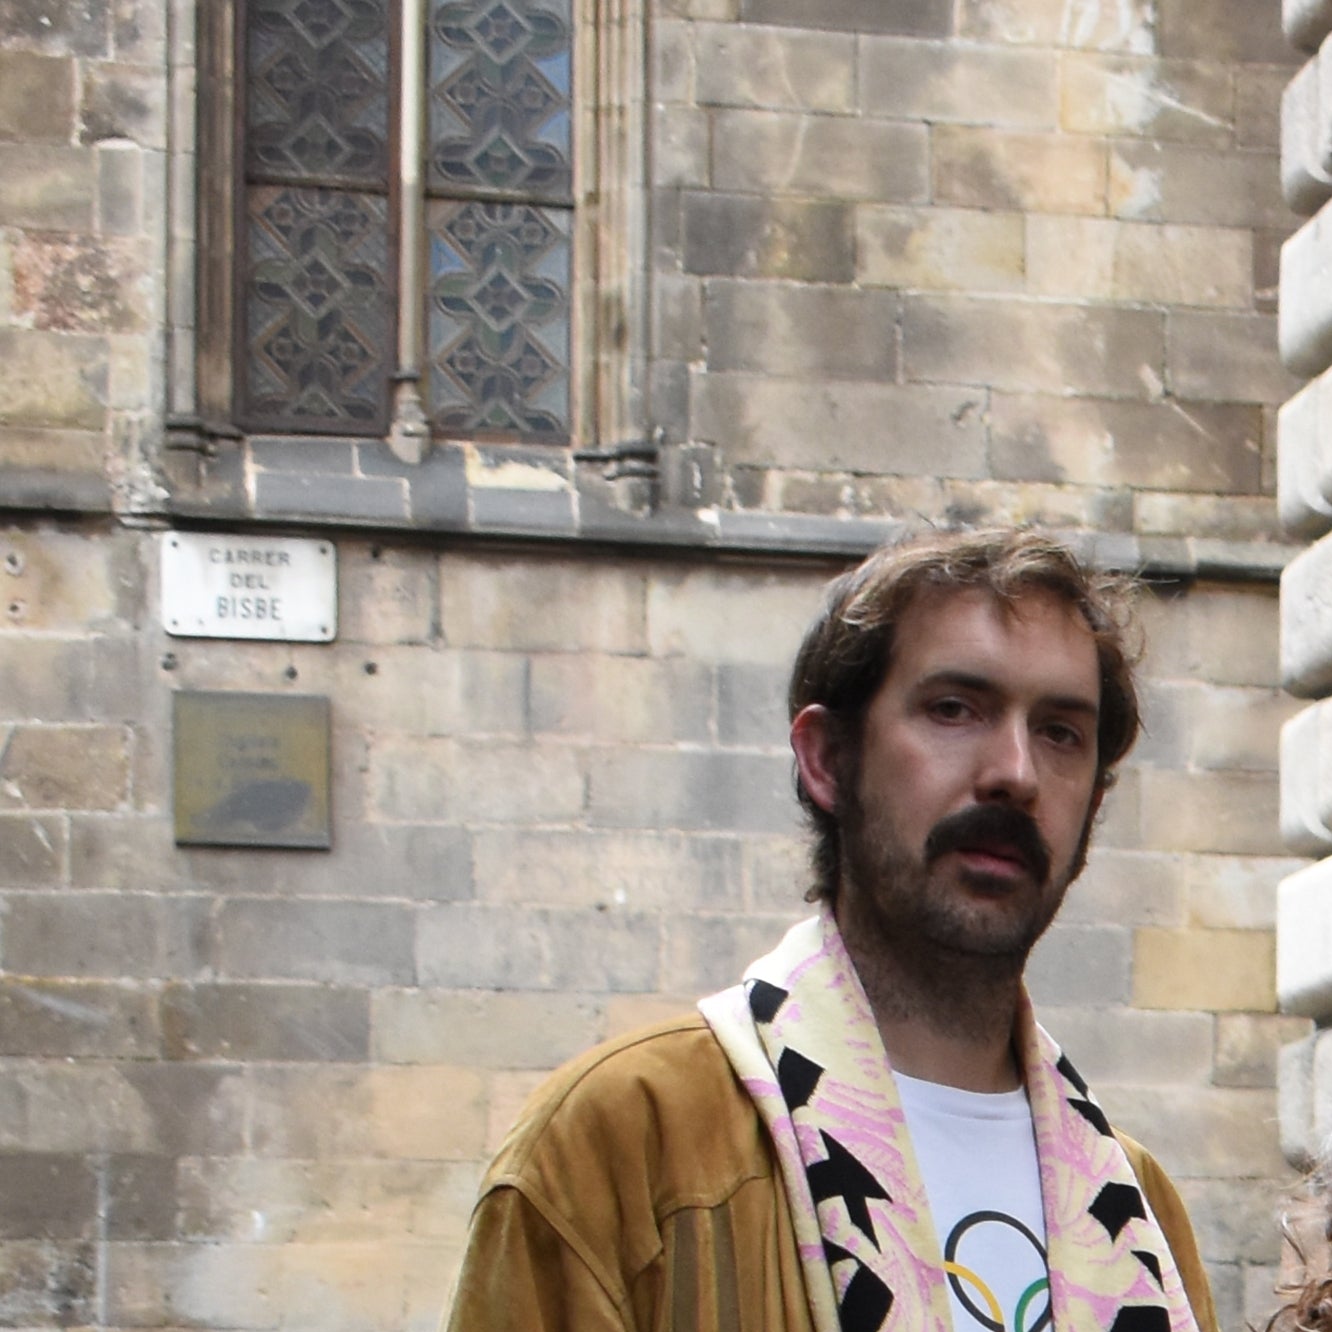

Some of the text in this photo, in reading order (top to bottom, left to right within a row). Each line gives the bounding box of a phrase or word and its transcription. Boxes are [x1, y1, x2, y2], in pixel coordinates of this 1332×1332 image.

[208, 548, 291, 567] CARRER
[230, 573, 269, 590] DEL
[216, 596, 283, 621] BISBE
